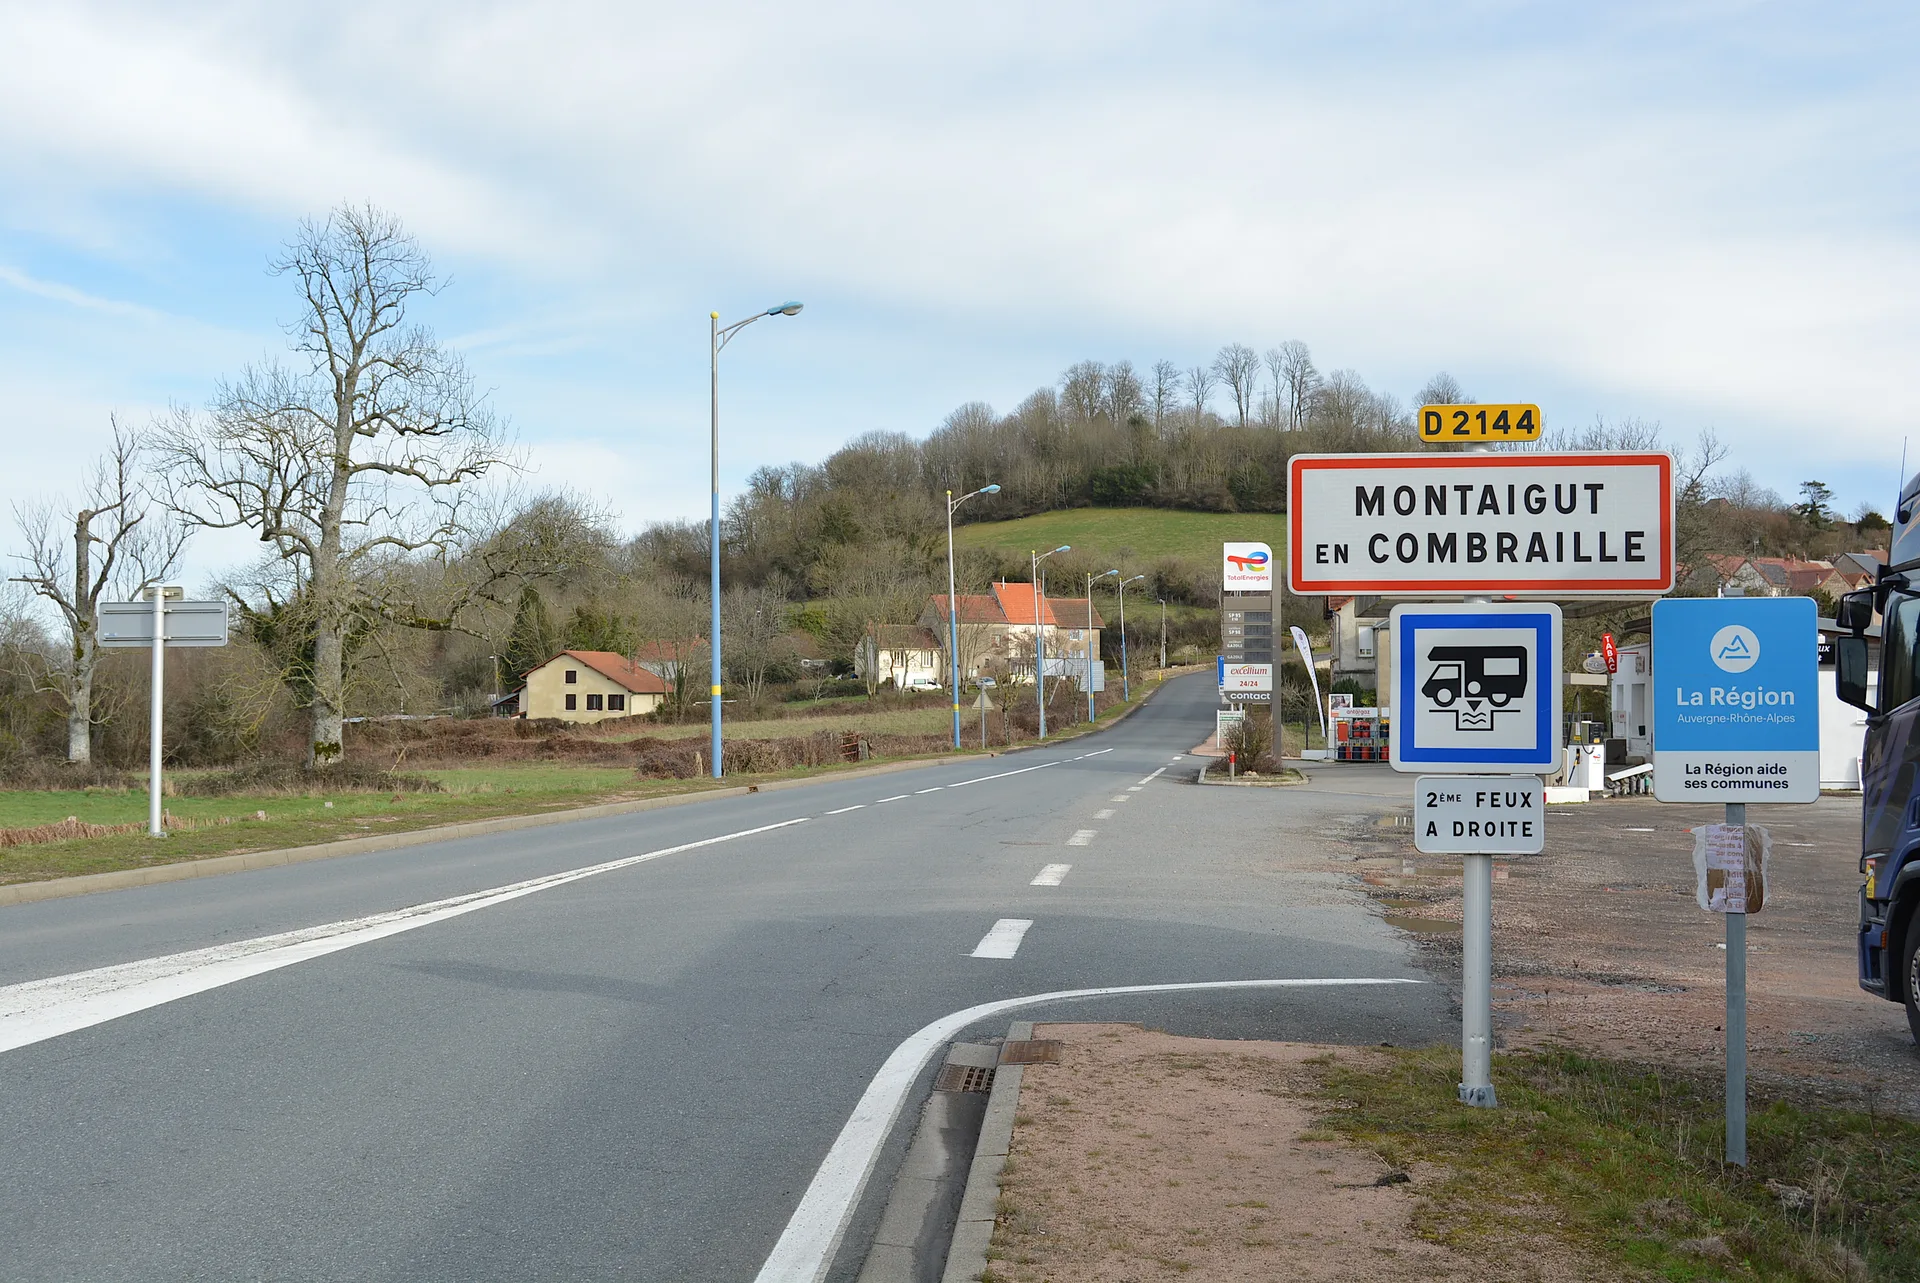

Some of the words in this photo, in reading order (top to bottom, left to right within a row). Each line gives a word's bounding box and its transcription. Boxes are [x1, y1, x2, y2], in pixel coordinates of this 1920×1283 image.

[1425, 411, 1442, 435] D
[1453, 410, 1536, 435] 2144
[1355, 483, 1605, 517] MONTAIGUT
[1316, 543, 1350, 564] EN
[1368, 530, 1646, 564] COMBRAILLE
[1227, 574, 1269, 582] TotalEnergies
[1604, 635, 1616, 671] TABAC
[1230, 666, 1268, 675] excellium
[1230, 692, 1271, 700] contact
[1677, 687, 1703, 706] La
[1710, 685, 1795, 710] Région
[1677, 712, 1796, 724] Auvergne-Rhône-Alpes
[1685, 763, 1702, 775] La
[1704, 761, 1754, 777] Région
[1757, 762, 1788, 775] aide
[1684, 779, 1709, 789] ses
[1710, 778, 1789, 790] communes
[1476, 791, 1532, 808] FEUX
[1426, 820, 1438, 837] A
[1453, 820, 1533, 837] DROITE
